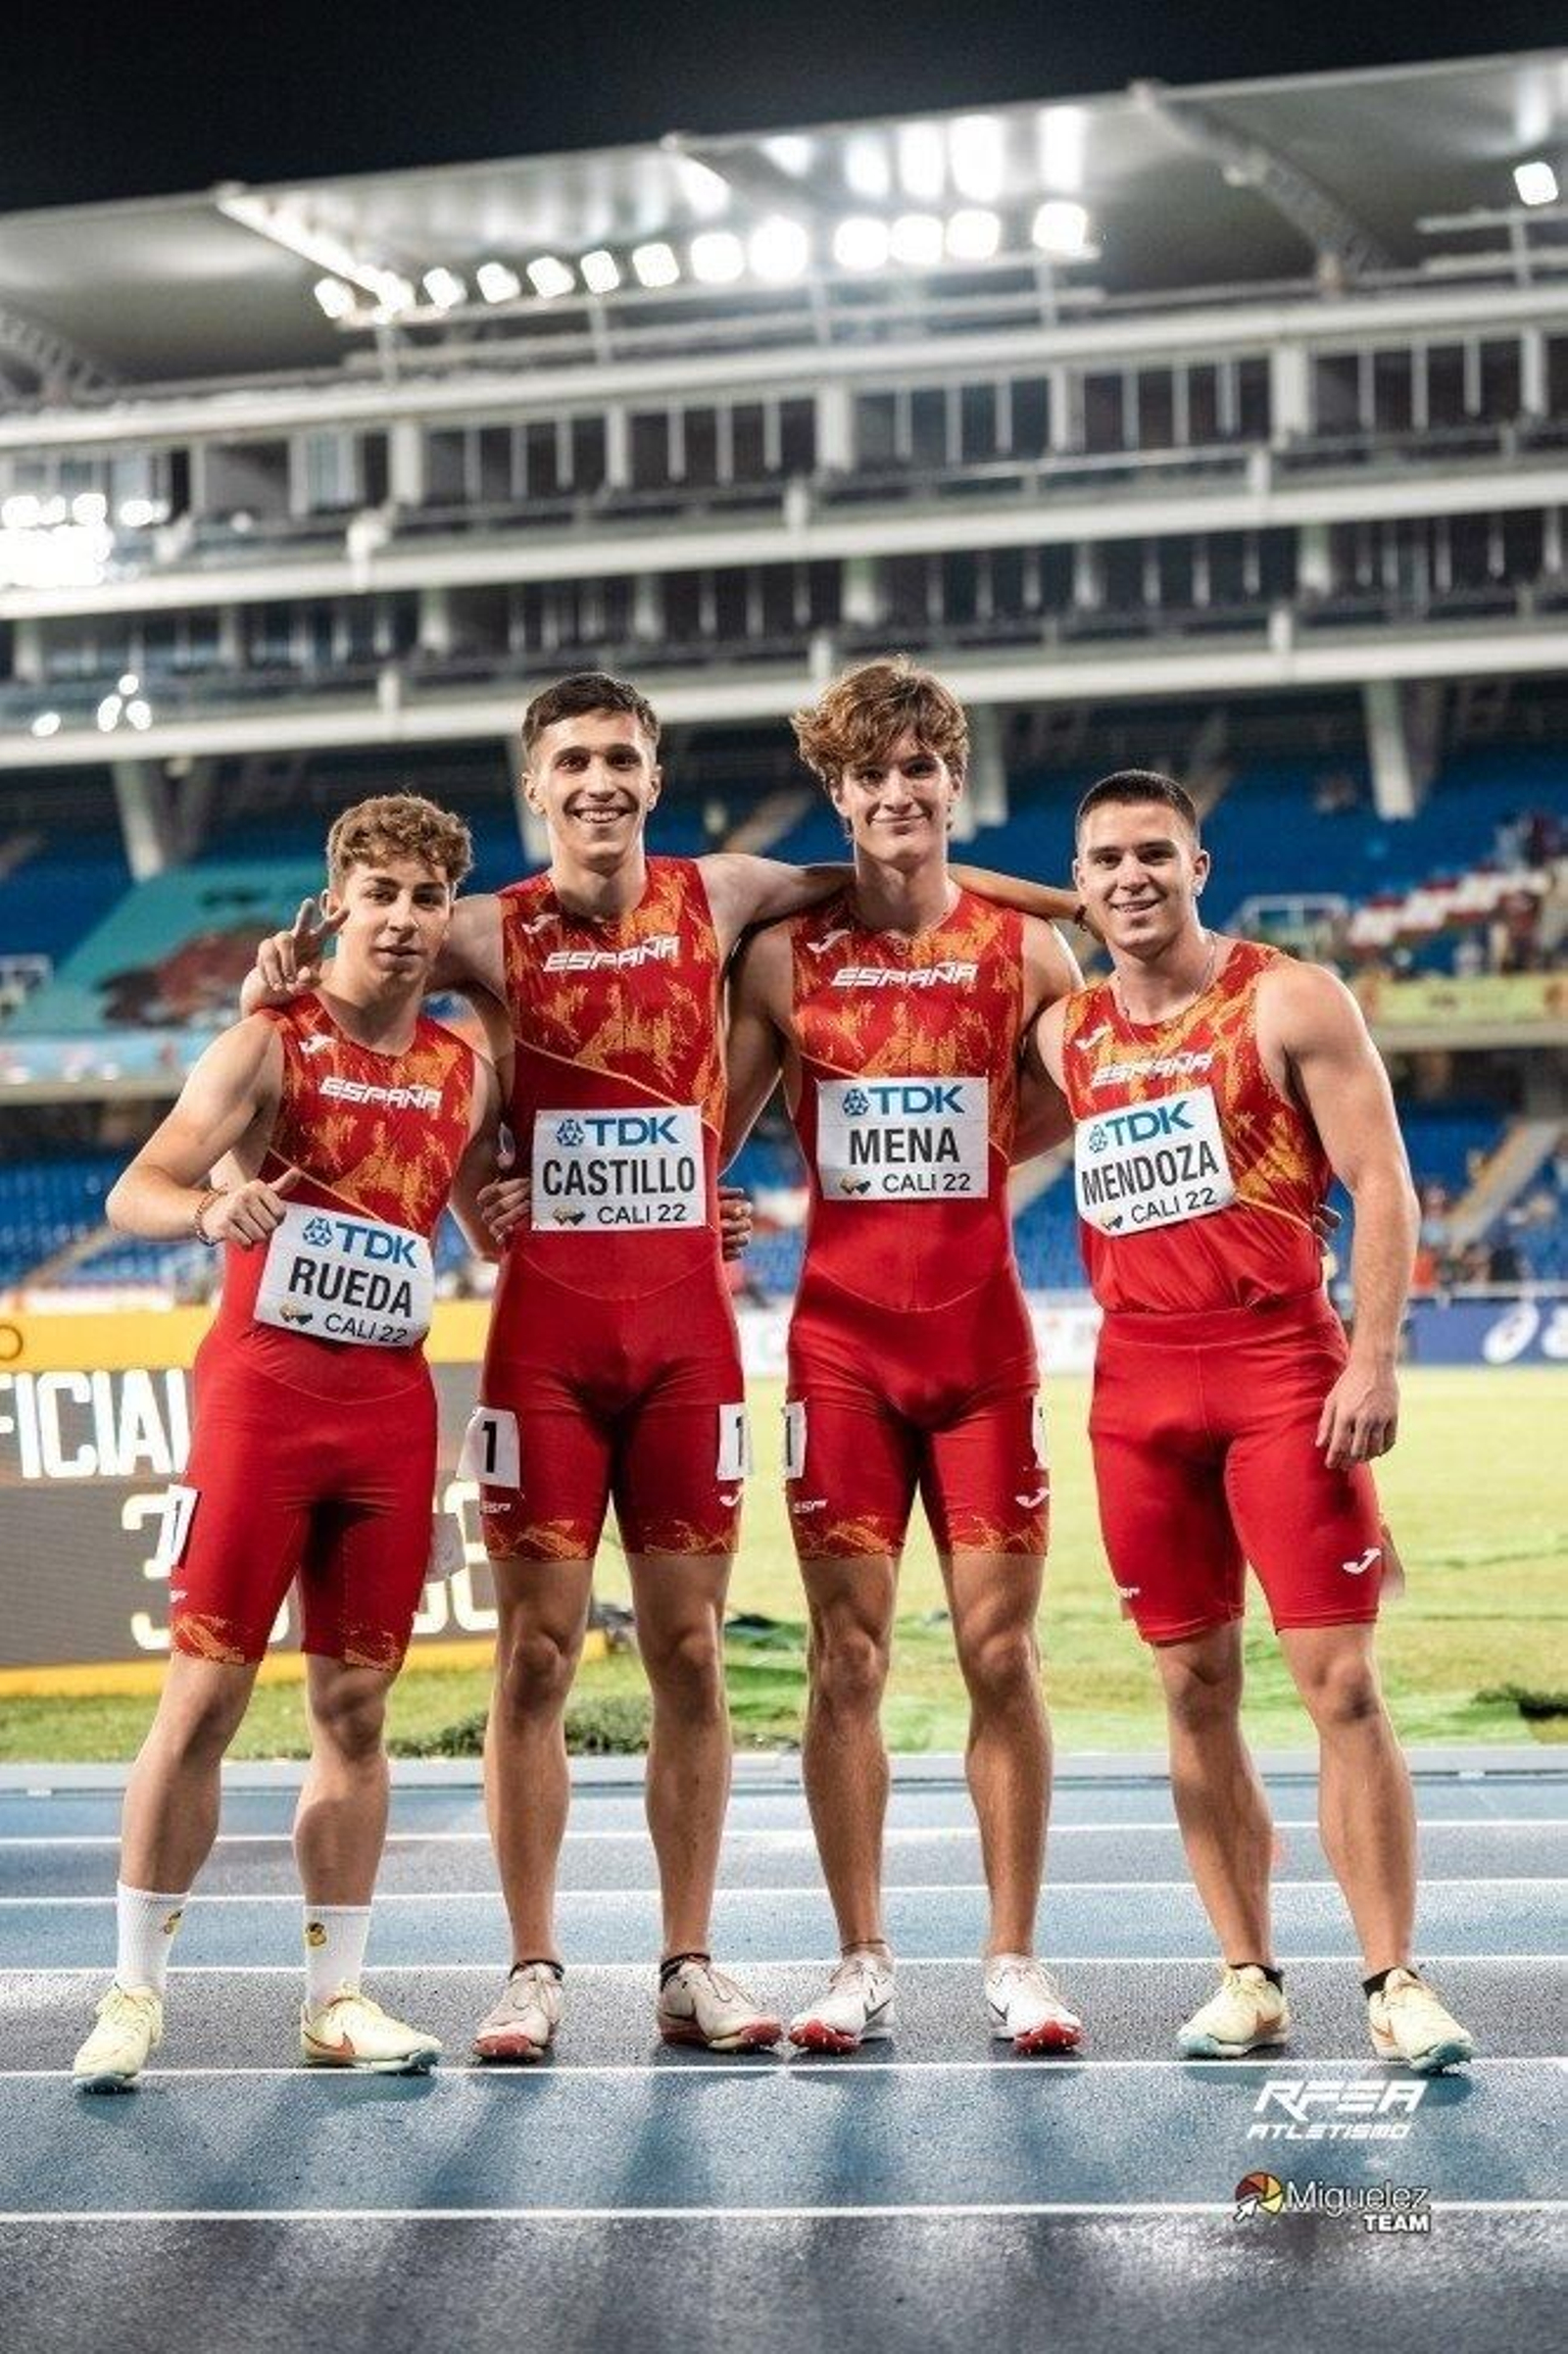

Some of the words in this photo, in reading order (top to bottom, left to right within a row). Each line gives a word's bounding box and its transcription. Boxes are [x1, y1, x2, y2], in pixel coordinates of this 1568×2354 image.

[543, 935, 680, 972] ESPAÑA
[831, 960, 979, 988] ESPAÑA
[319, 1075, 443, 1110] ESPAÑA
[868, 1086, 965, 1114] TDK
[585, 1115, 680, 1147] TDK
[1105, 1101, 1195, 1147] TDK
[849, 1126, 961, 1165] MENA
[542, 1156, 696, 1196] CASTILLO
[883, 1174, 937, 1193] CALI
[943, 1173, 971, 1192] 22
[1081, 1141, 1219, 1205] MENDOZA
[597, 1205, 651, 1225] CALI
[658, 1203, 687, 1222] 22
[1131, 1197, 1180, 1223] CALI
[1185, 1187, 1217, 1210] 22
[336, 1222, 417, 1268] TDK
[288, 1256, 413, 1317] RUEDA
[324, 1312, 376, 1341] CALI
[378, 1323, 408, 1344] 22
[482, 1420, 497, 1473] 1
